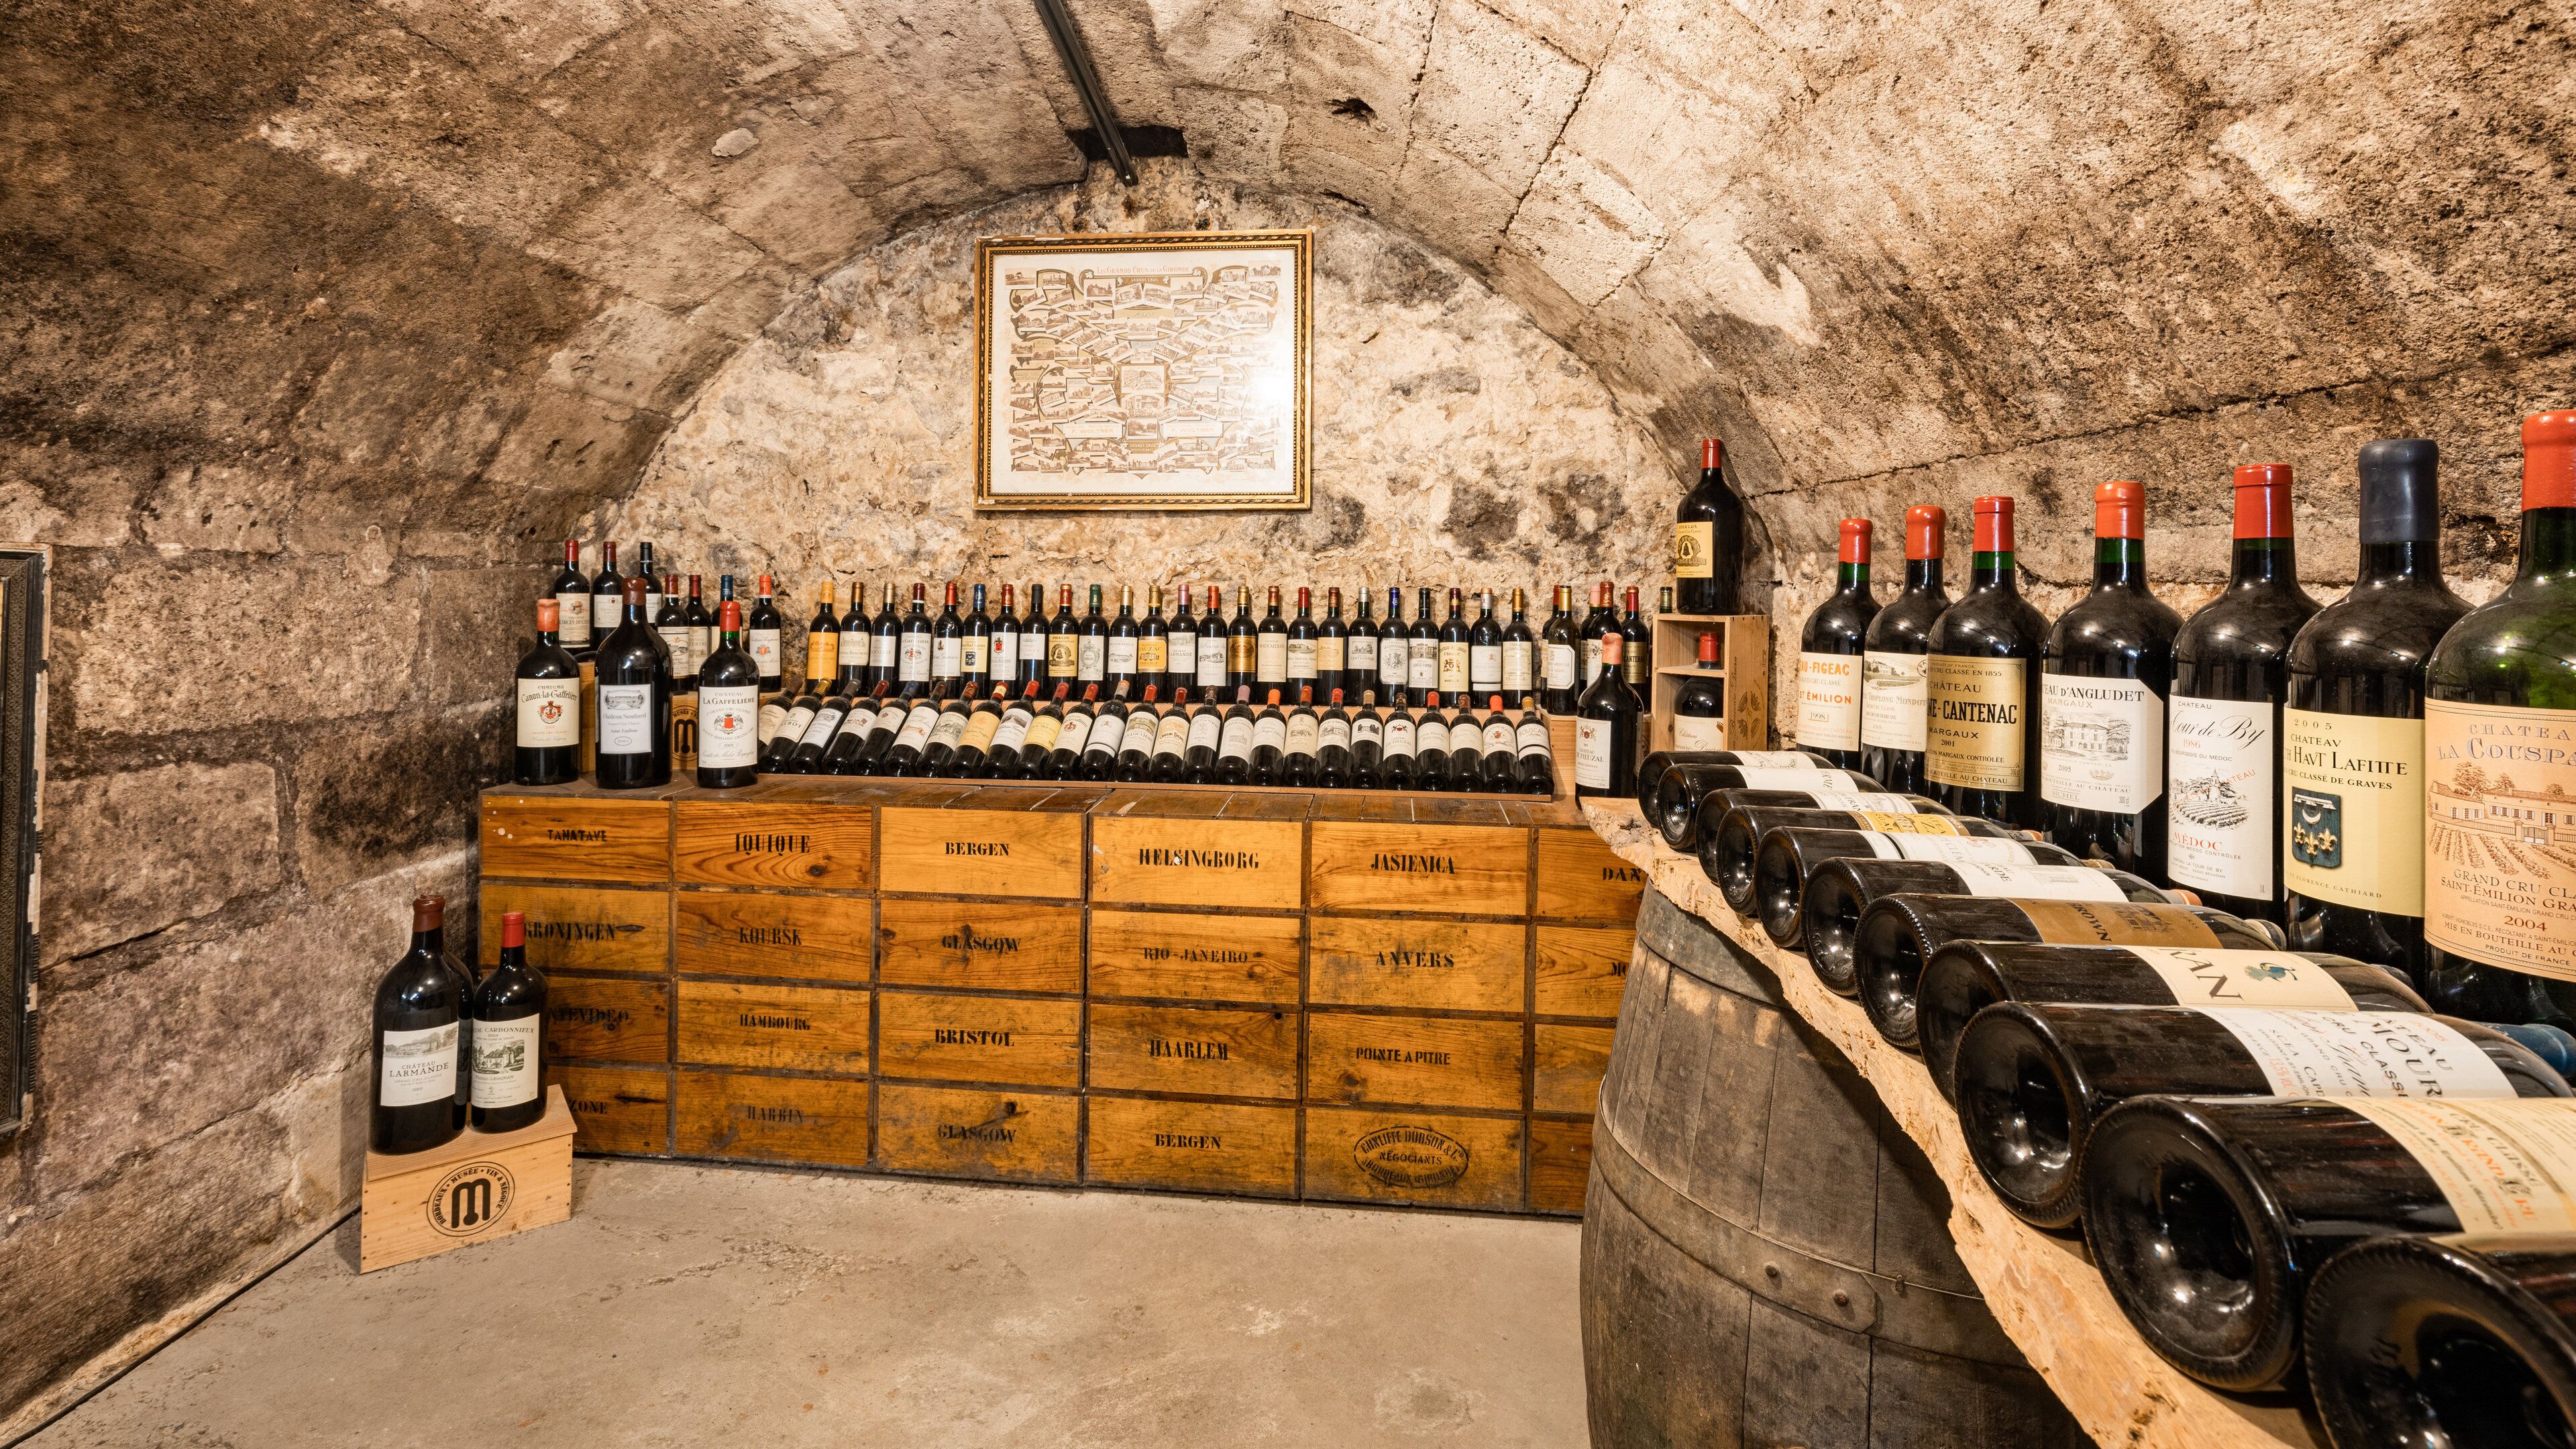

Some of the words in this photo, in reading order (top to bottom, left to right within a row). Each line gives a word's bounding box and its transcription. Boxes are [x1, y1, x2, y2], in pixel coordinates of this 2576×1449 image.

[1945, 667, 1970, 676] CLASSÉ
[1929, 680, 1982, 693] CHÂTEAU
[2043, 684, 2059, 696] TEAU
[2061, 686, 2145, 702] d'ANGLUDET
[712, 697, 755, 705] GAFFELIÈRE
[1807, 690, 1852, 704] ÉMILION
[1896, 696, 1927, 706] MONDOT
[2047, 698, 2093, 709] MARGAUX
[2178, 700, 2212, 710] CHATEAU
[1810, 712, 1826, 720] 1998
[1927, 698, 2017, 724] NE-CANTENAC
[1929, 726, 1979, 739] MARGAUX
[2171, 710, 2196, 737] Tour
[2197, 720, 2216, 739] de
[2218, 714, 2266, 751] By
[2468, 723, 2571, 741] CHATEA
[1941, 739, 1955, 747] 2001
[2183, 738, 2201, 749] 1986
[1580, 753, 1605, 763] FIEUZAL
[1938, 751, 1965, 760] MARGAUX
[1967, 753, 2004, 763] CONTRÔLÉE
[2436, 744, 2460, 761] LA
[2058, 763, 2072, 773] 2005
[2332, 751, 2408, 776] LAFITTE
[1960, 773, 1970, 781] AU
[1972, 775, 2008, 784] CHATEAU
[2288, 767, 2298, 777] CRU
[2300, 771, 2328, 783] CLASSÉ
[2330, 775, 2344, 786] DE
[2347, 779, 2393, 790] GRAVES
[2051, 790, 2080, 801] SICHEL
[547, 828, 608, 843] TAMATAVE
[2173, 831, 2222, 851] MÉDOC
[735, 833, 810, 857] IQUIQUE
[944, 841, 1010, 857] BERGEN
[1139, 848, 1260, 870] HELSINGBORG
[1371, 853, 1456, 875] JASIENICA
[1602, 867, 1642, 882] DAN
[2454, 868, 2500, 888] GRAND
[2506, 879, 2541, 894] CRU
[2296, 875, 2330, 890] FLORENCE
[2333, 884, 2382, 899] CATHIARD
[2441, 875, 2536, 906] SAINT-ÉMILION
[2542, 898, 2576, 912] GRA
[2461, 894, 2493, 908] APPELLATION
[2532, 908, 2554, 918] GRAND
[2555, 912, 2569, 920] CRU
[524, 922, 615, 941] GRONINGEN
[2068, 902, 2113, 943] BROWN
[2455, 916, 2479, 928] VIGNOBLES
[2495, 926, 2527, 939] RÉCOLTANT
[2504, 914, 2548, 932] 2004
[739, 926, 802, 947] KOURSK
[941, 934, 1021, 953] GLASGOW
[2444, 920, 2458, 931] MIS
[2460, 926, 2473, 935] EN
[2476, 930, 2544, 952] BOUTEILLE
[2547, 945, 2567, 956] AU
[1376, 950, 1454, 968] ANVERS
[2485, 943, 2518, 957] PRODUIT
[2522, 952, 2532, 960] DE
[2535, 955, 2571, 967] FRANCE
[549, 1008, 629, 1024] NTEVIDEO
[740, 1013, 811, 1032] HAMBOURG
[2322, 1016, 2357, 1034] CRU
[934, 1028, 1015, 1048] BRISTOL
[1148, 1039, 1229, 1061] HAARLEM
[1356, 1046, 1403, 1063] POINTE
[1404, 1053, 1413, 1063] A
[1415, 1051, 1451, 1066] PITRE
[401, 1061, 436, 1071] CHÂTEAU
[2371, 1022, 2444, 1098] MOUR
[389, 1062, 449, 1078] LARMANDE
[2330, 1065, 2347, 1086] CRU
[569, 1099, 608, 1115] ZONE
[747, 1105, 804, 1124] HARBIN
[936, 1123, 1017, 1144] GLASGOW
[1155, 1132, 1223, 1150] BERGEN
[1360, 1130, 1401, 1155] CUNLIFFE
[1405, 1131, 1445, 1151] DOBSON
[1379, 1150, 1443, 1166] NÉGOCIANTS
[433, 1188, 448, 1225] BORDEAUX
[450, 1167, 479, 1184] MUSÉE
[485, 1168, 500, 1178] VIN
[495, 1180, 509, 1210] NÉGOCE
